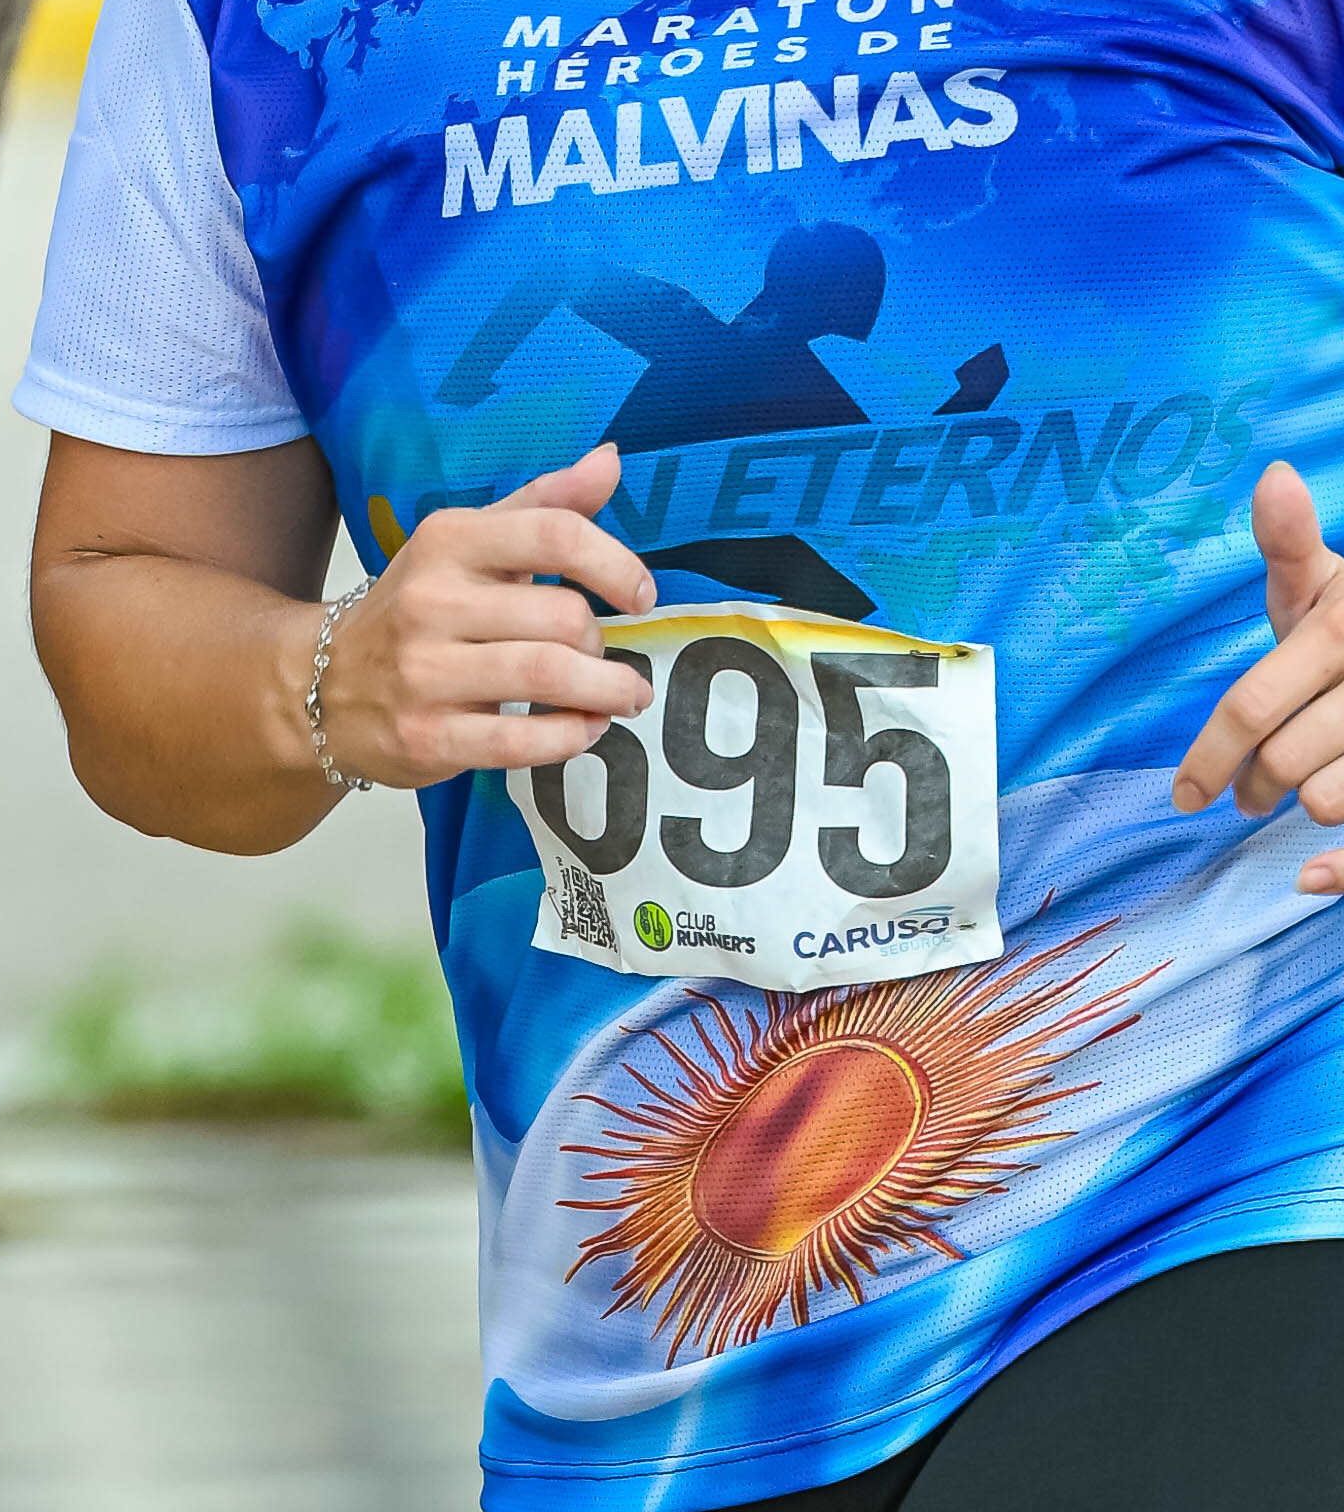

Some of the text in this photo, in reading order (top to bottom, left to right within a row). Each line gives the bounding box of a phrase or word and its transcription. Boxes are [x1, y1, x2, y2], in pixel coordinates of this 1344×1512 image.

[496, 20, 954, 96] HÉROES DE
[440, 68, 1020, 218] MALVINAS
[710, 382, 1268, 530] ETERNOS
[529, 636, 952, 899] 695
[675, 911, 717, 931] CLUB
[676, 929, 757, 955] RUNNER'S
[793, 917, 950, 959] CARUSO
